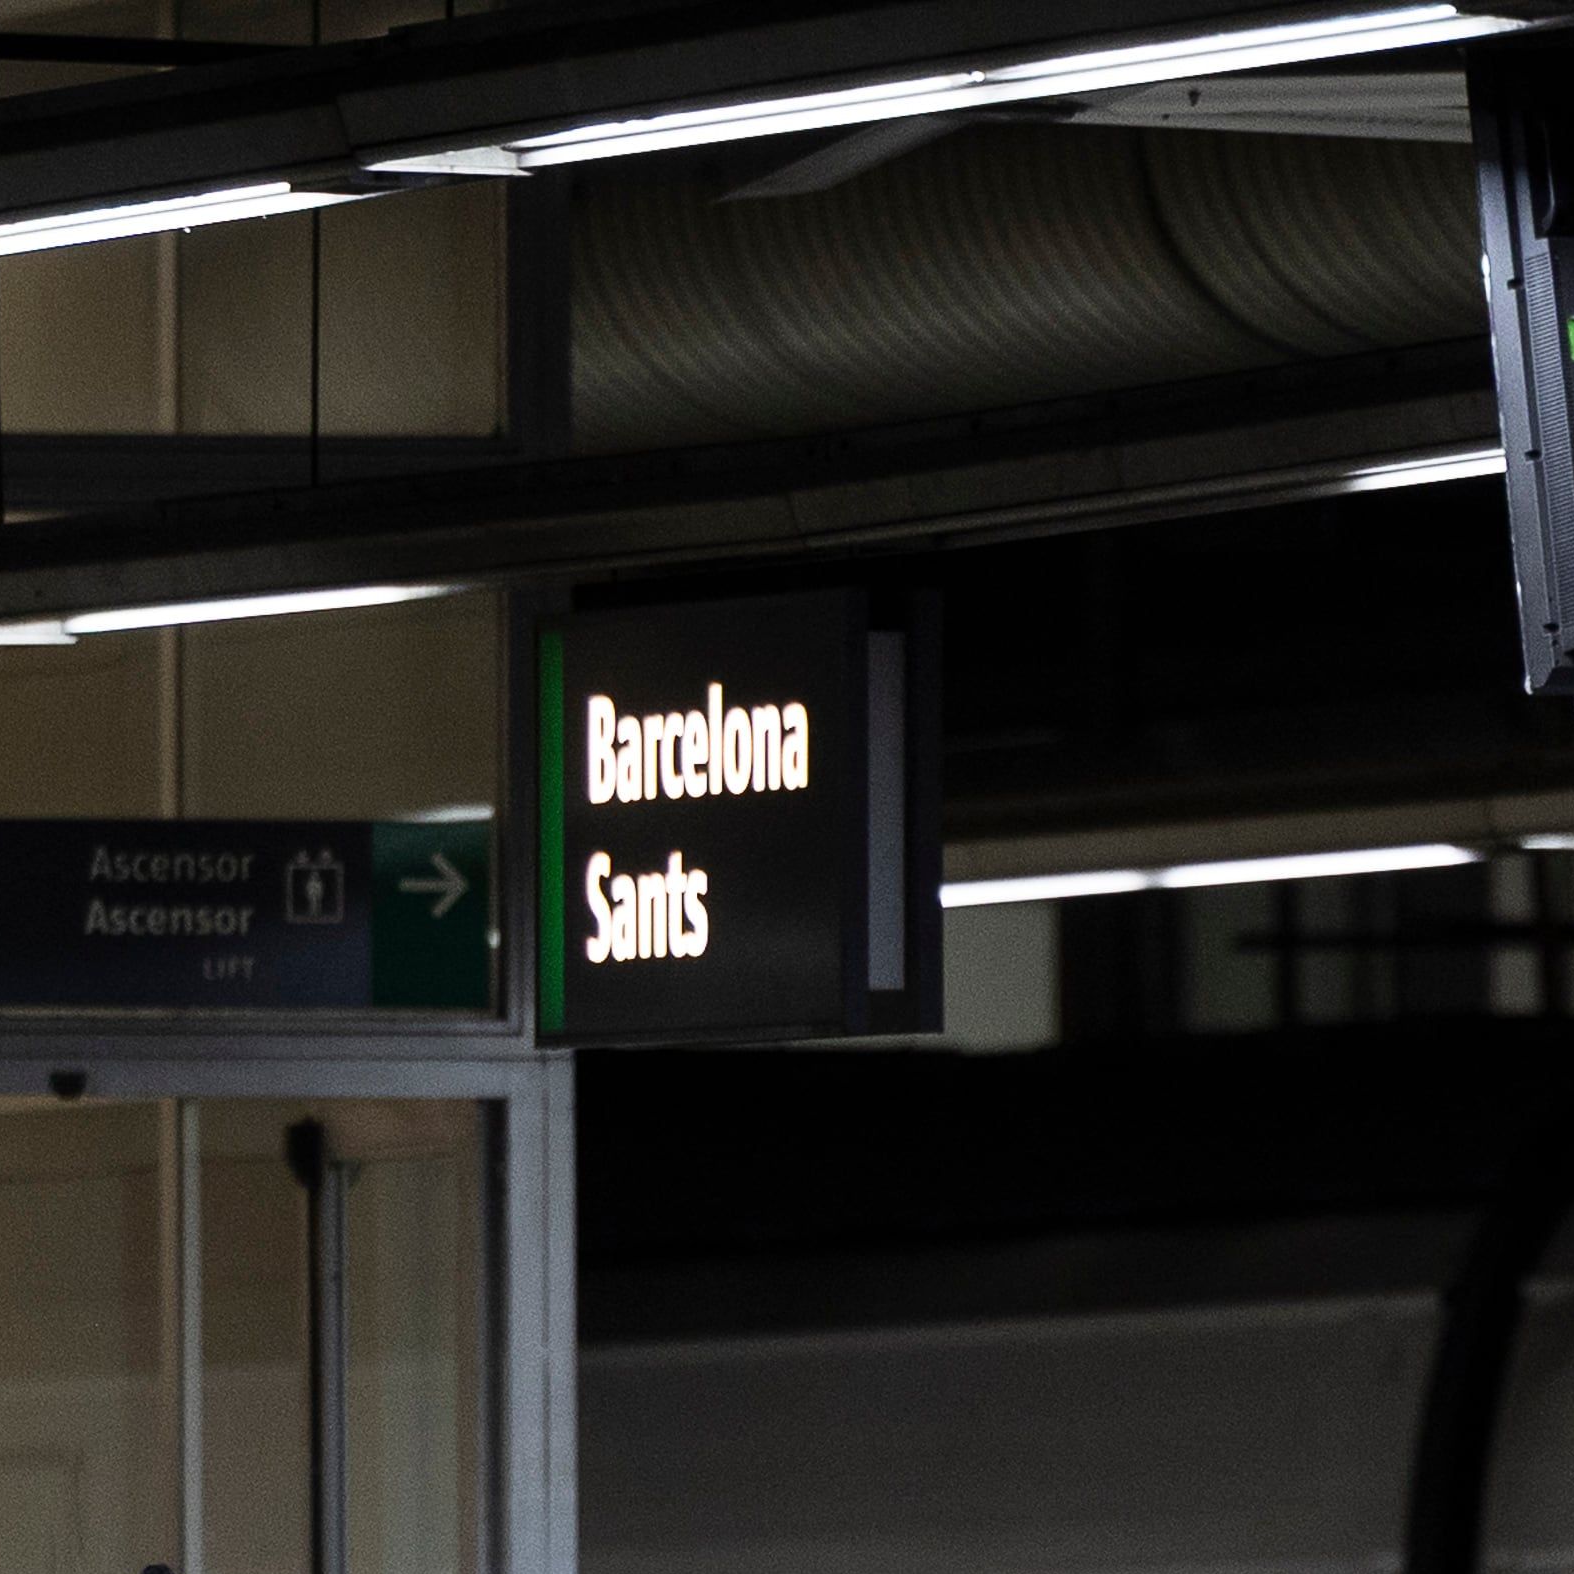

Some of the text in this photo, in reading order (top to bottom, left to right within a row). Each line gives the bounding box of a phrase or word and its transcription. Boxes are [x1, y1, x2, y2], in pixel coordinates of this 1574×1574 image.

[587, 681, 809, 804] Barcelona
[89, 846, 255, 882] Ascensor
[84, 897, 255, 936] Ascensor
[585, 850, 709, 963] Sants
